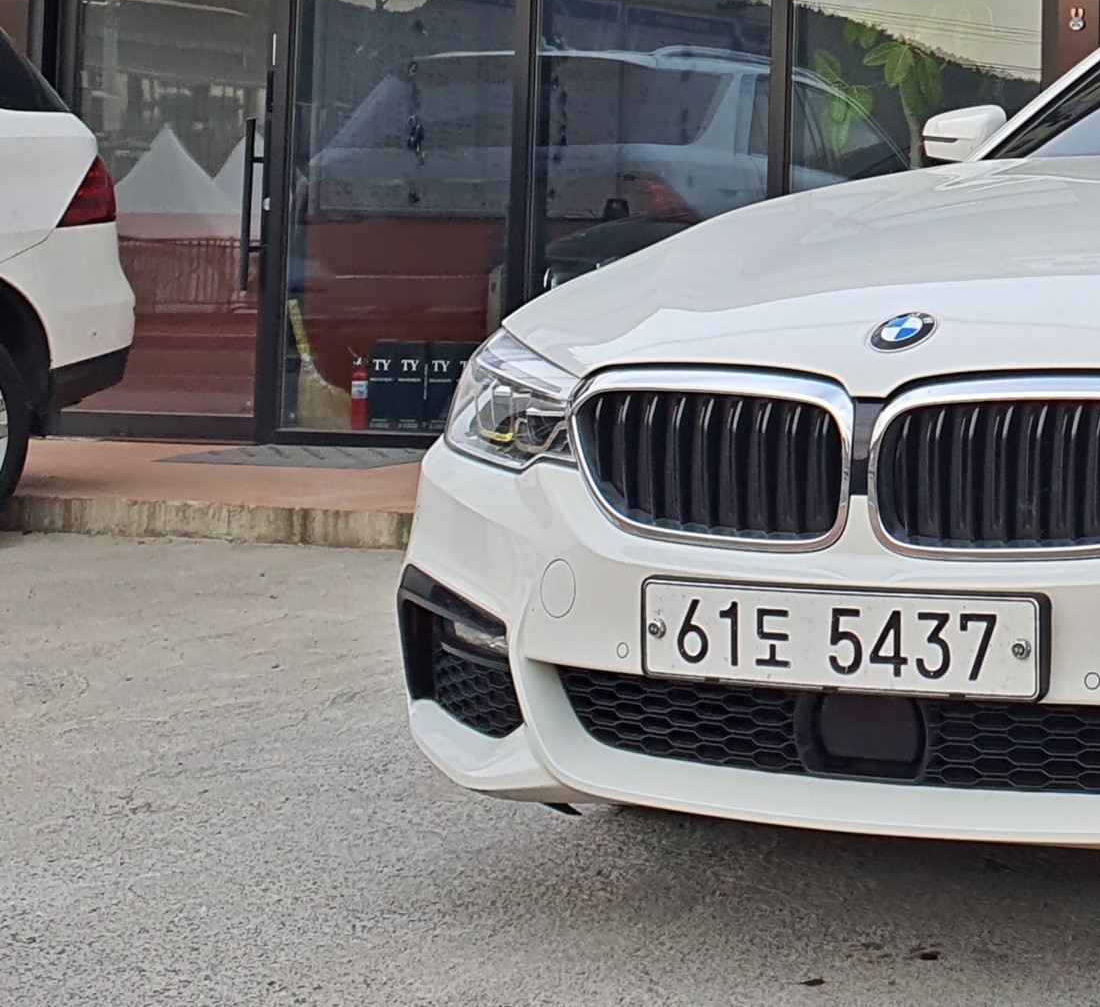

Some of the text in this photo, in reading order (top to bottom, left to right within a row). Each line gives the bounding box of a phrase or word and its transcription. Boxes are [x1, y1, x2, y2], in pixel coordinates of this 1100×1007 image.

[373, 359, 391, 371] TY
[401, 359, 419, 372] TY
[432, 360, 450, 372] TY
[676, 598, 997, 681] 61도 5437
